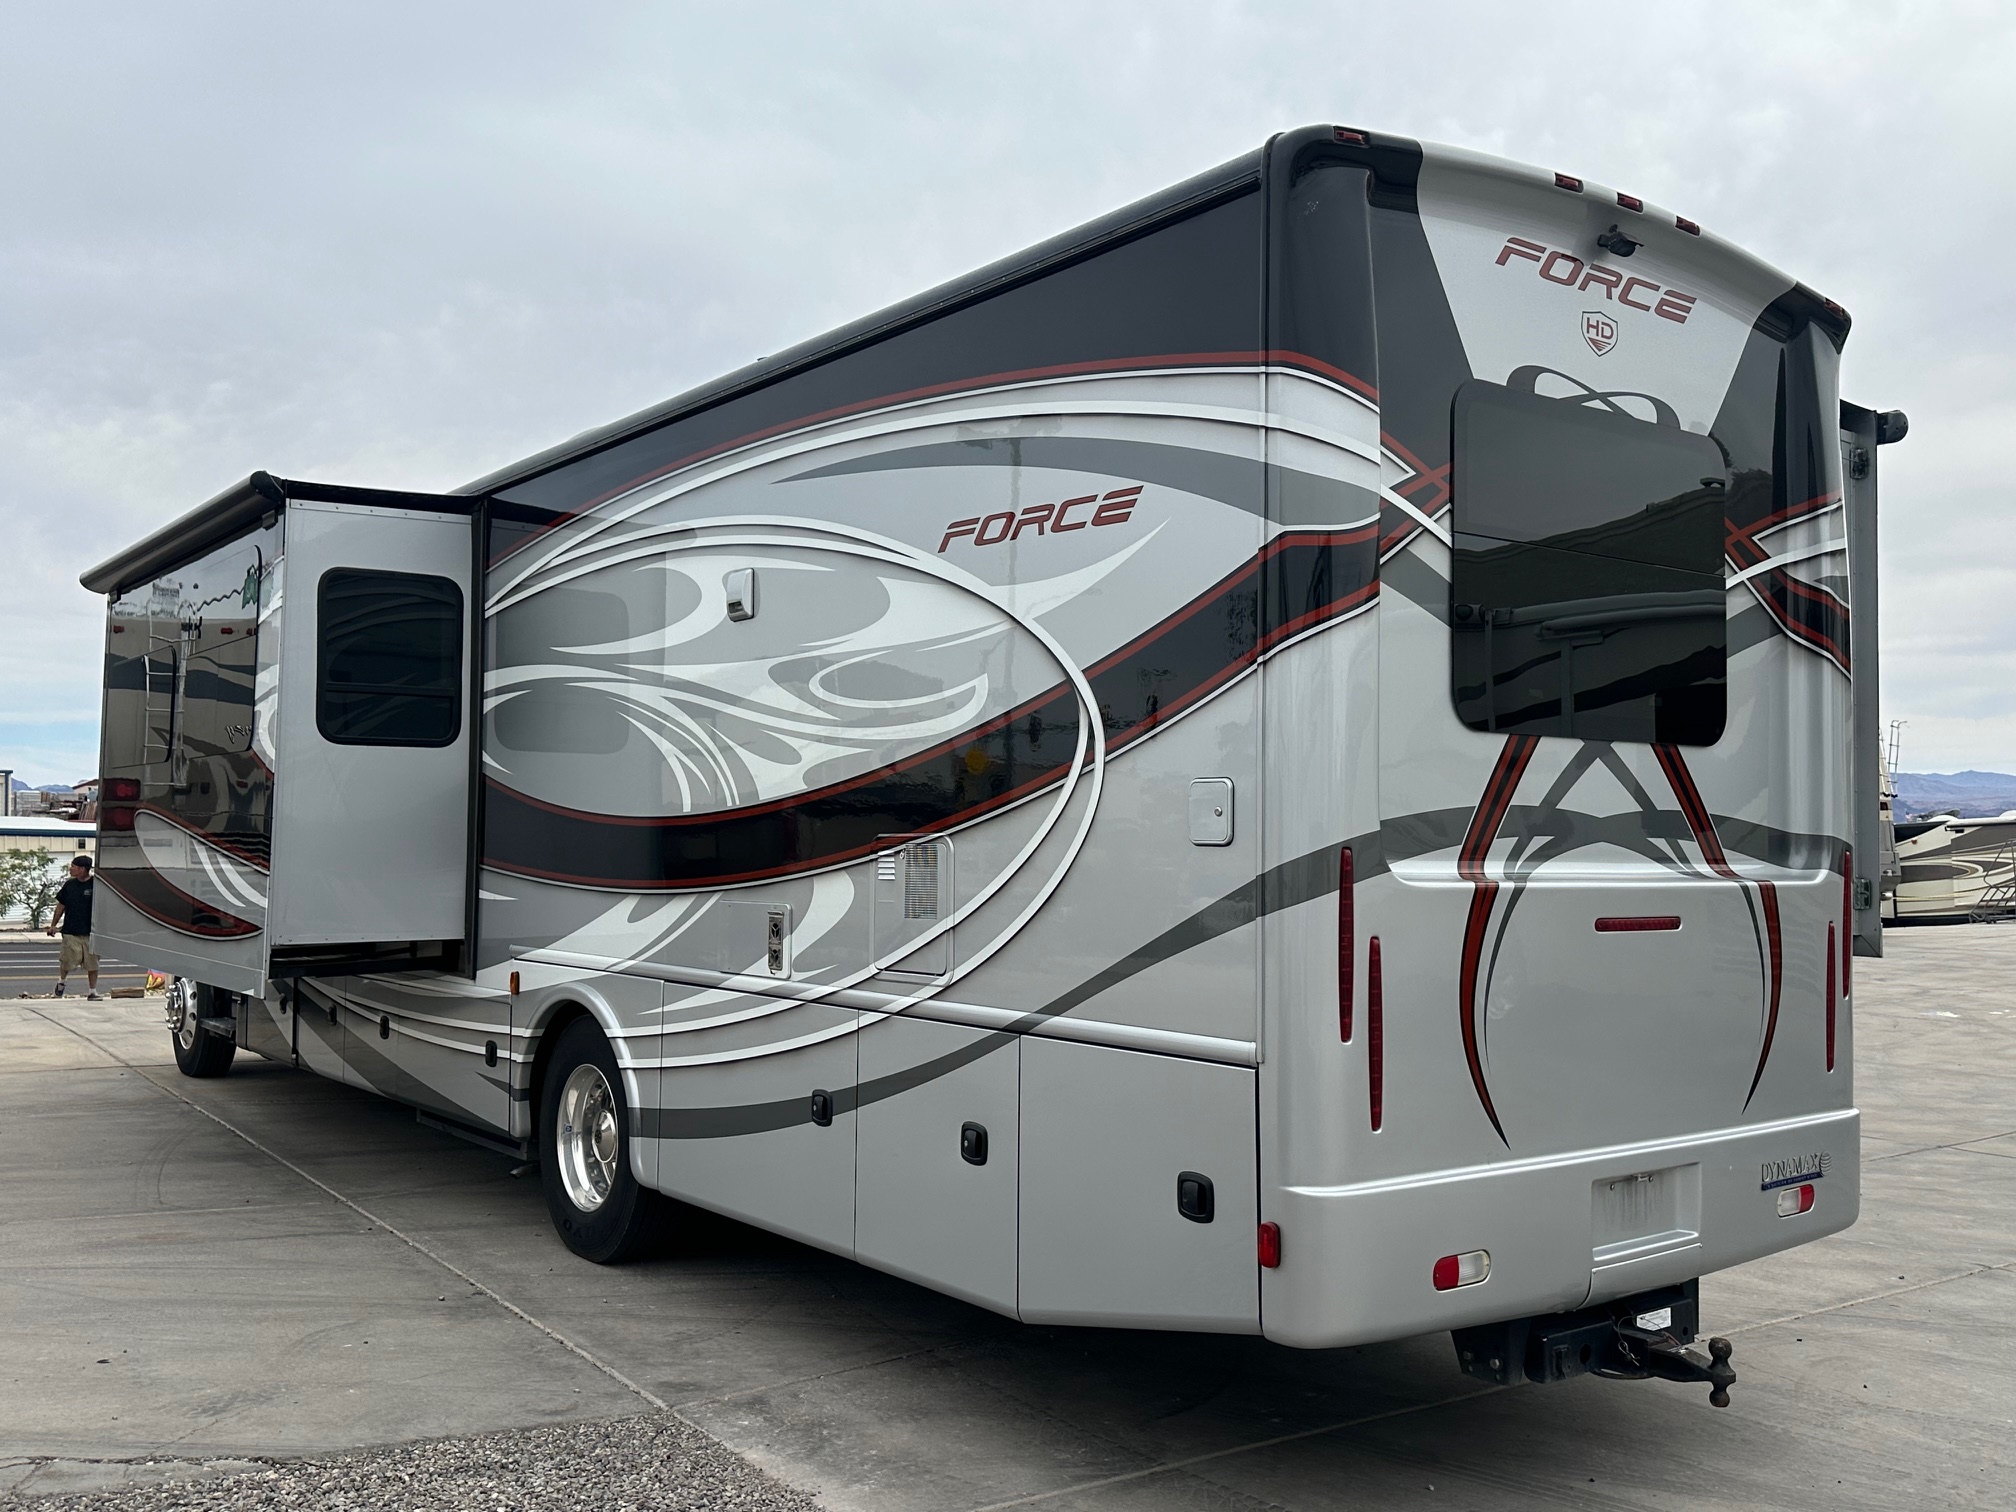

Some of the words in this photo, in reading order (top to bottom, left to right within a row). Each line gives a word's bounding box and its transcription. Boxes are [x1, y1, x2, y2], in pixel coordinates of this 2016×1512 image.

[1495, 236, 1698, 324] FORCE
[1586, 316, 1614, 340] HD
[937, 485, 1144, 553] FORCE
[1761, 1152, 1820, 1182] DYNAMAX
